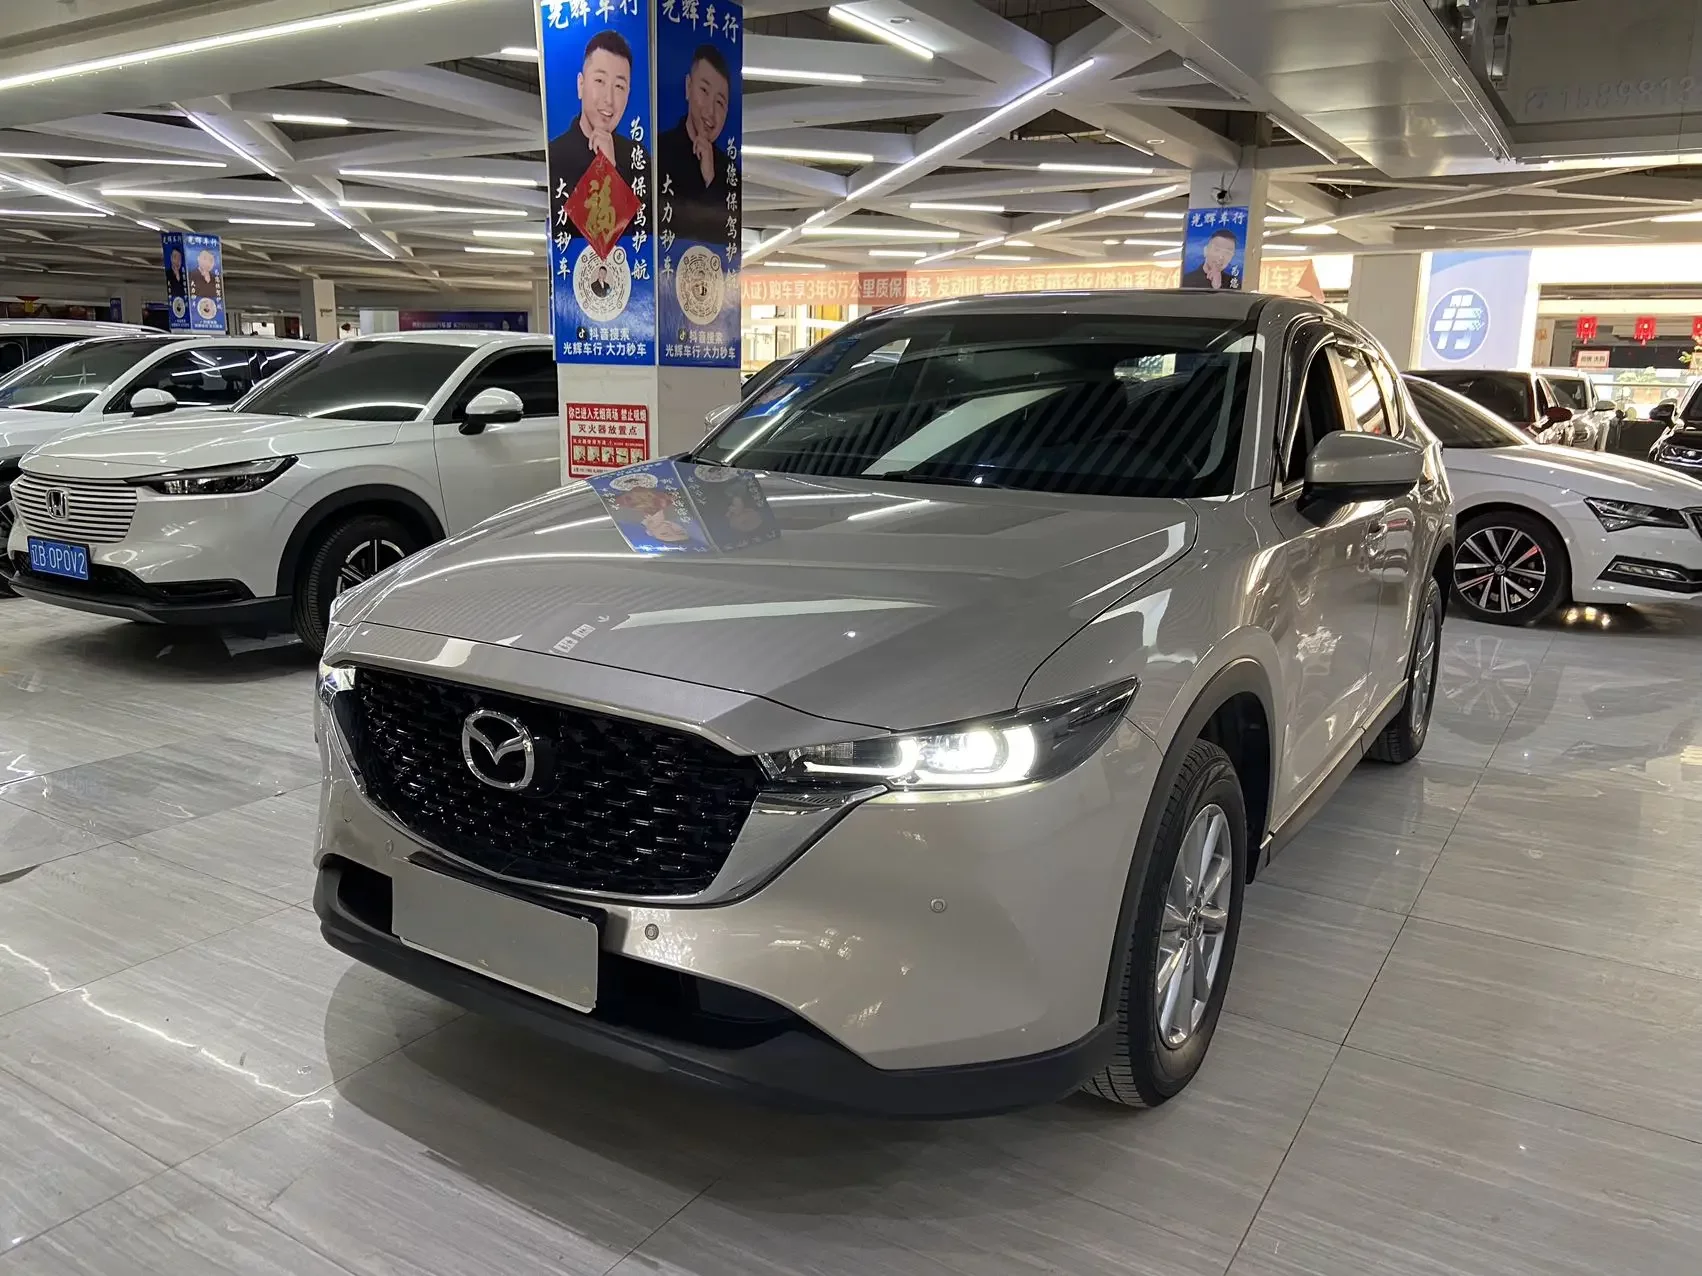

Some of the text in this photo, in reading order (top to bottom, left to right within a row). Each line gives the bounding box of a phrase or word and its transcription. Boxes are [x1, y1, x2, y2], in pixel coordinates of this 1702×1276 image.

[659, 173, 676, 280] 大力秒车
[1191, 211, 1245, 228] 光辉车行
[554, 177, 572, 282] 大力秒车
[589, 327, 630, 341] 抖音搜索
[563, 342, 647, 357] 光辉车行 大力秒车
[665, 344, 736, 360] 光辉车行 大力秒车
[578, 423, 638, 436] 灭火器放置点
